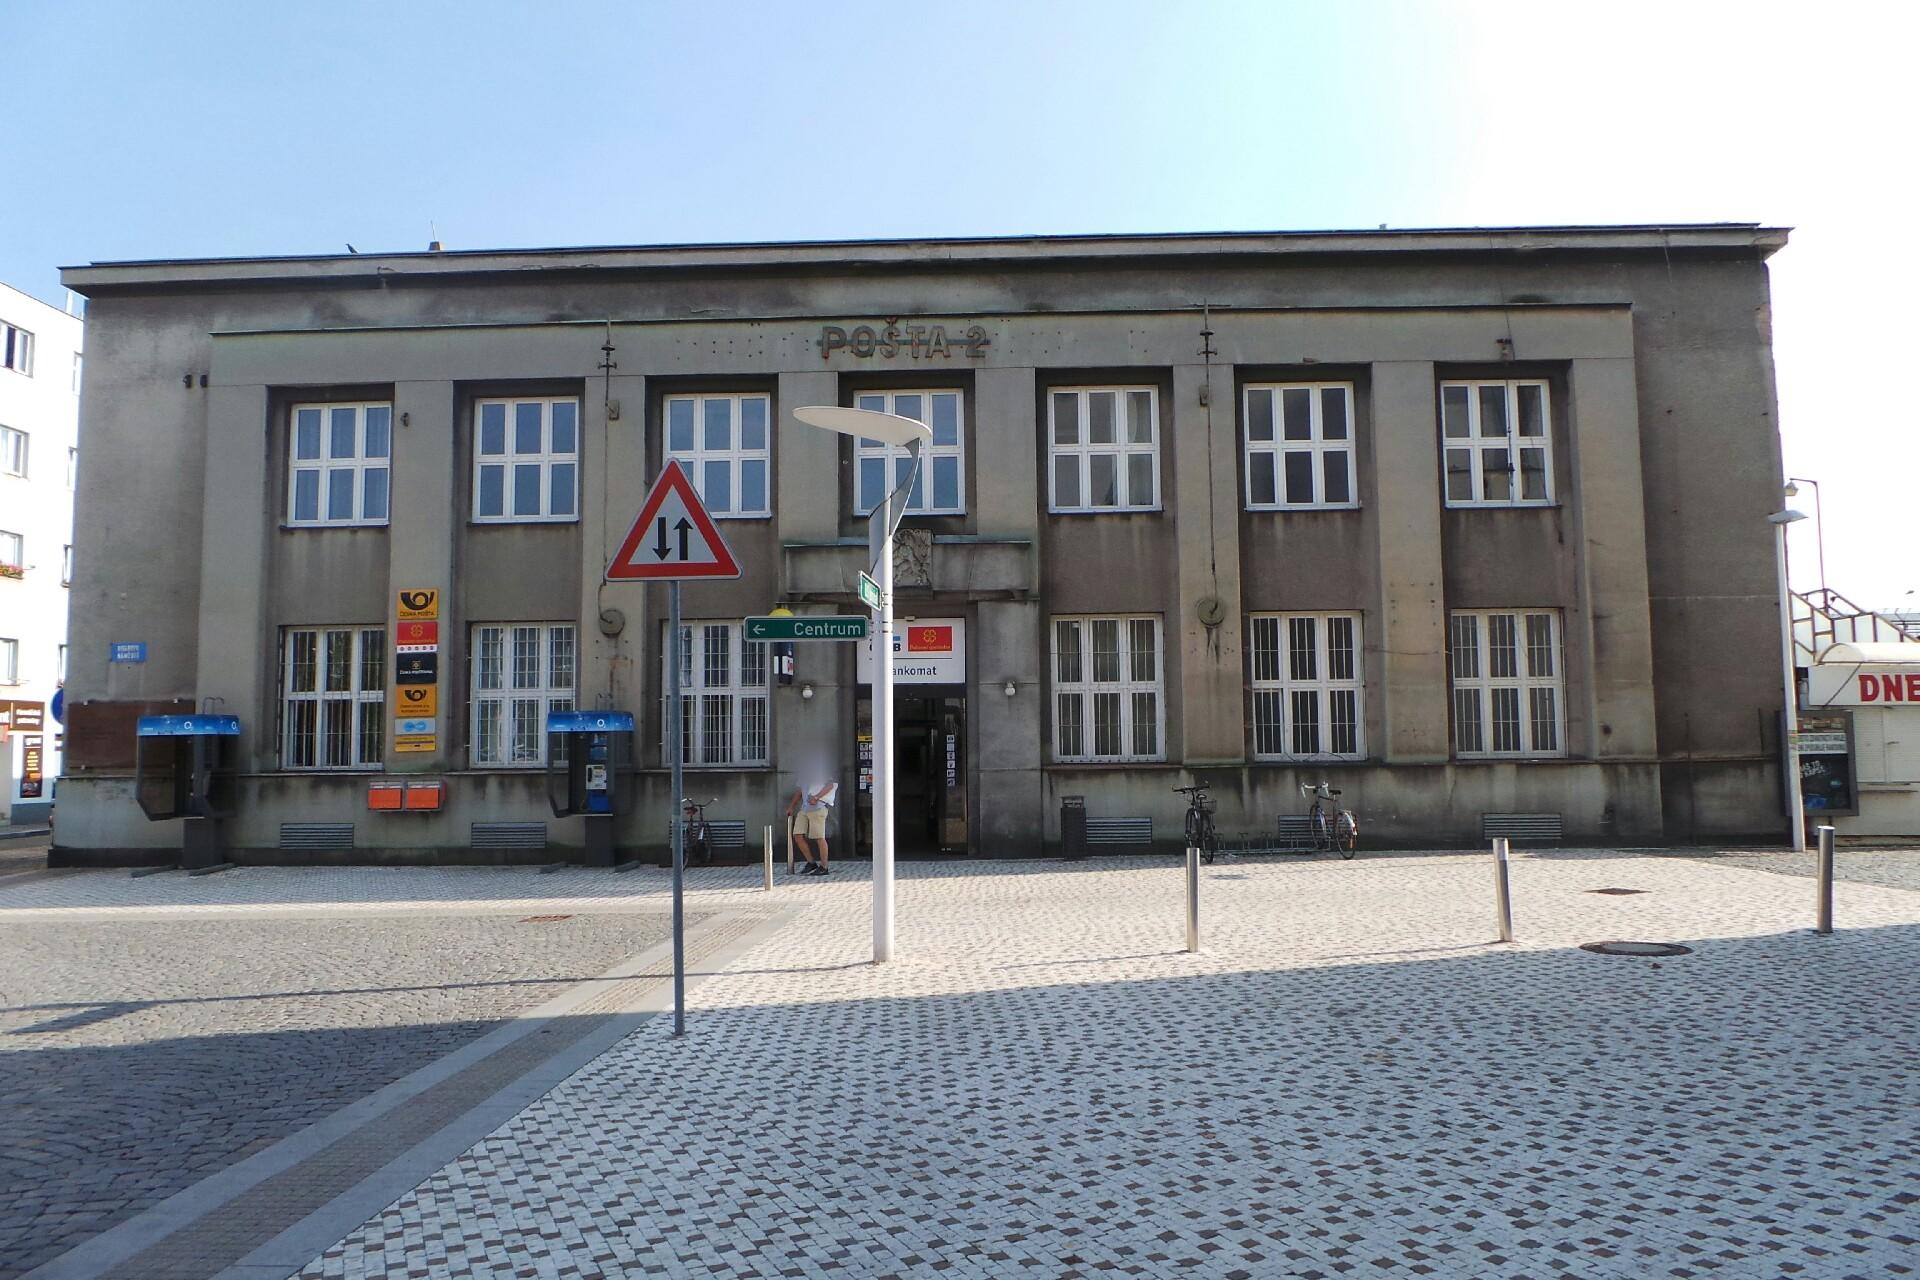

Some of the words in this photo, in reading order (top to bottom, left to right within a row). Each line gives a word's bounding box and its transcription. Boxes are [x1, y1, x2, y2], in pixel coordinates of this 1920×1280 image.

[821, 316, 951, 360] POŠTA
[965, 324, 987, 359] 2
[793, 622, 861, 637] Centrum
[893, 665, 937, 676] ankomat
